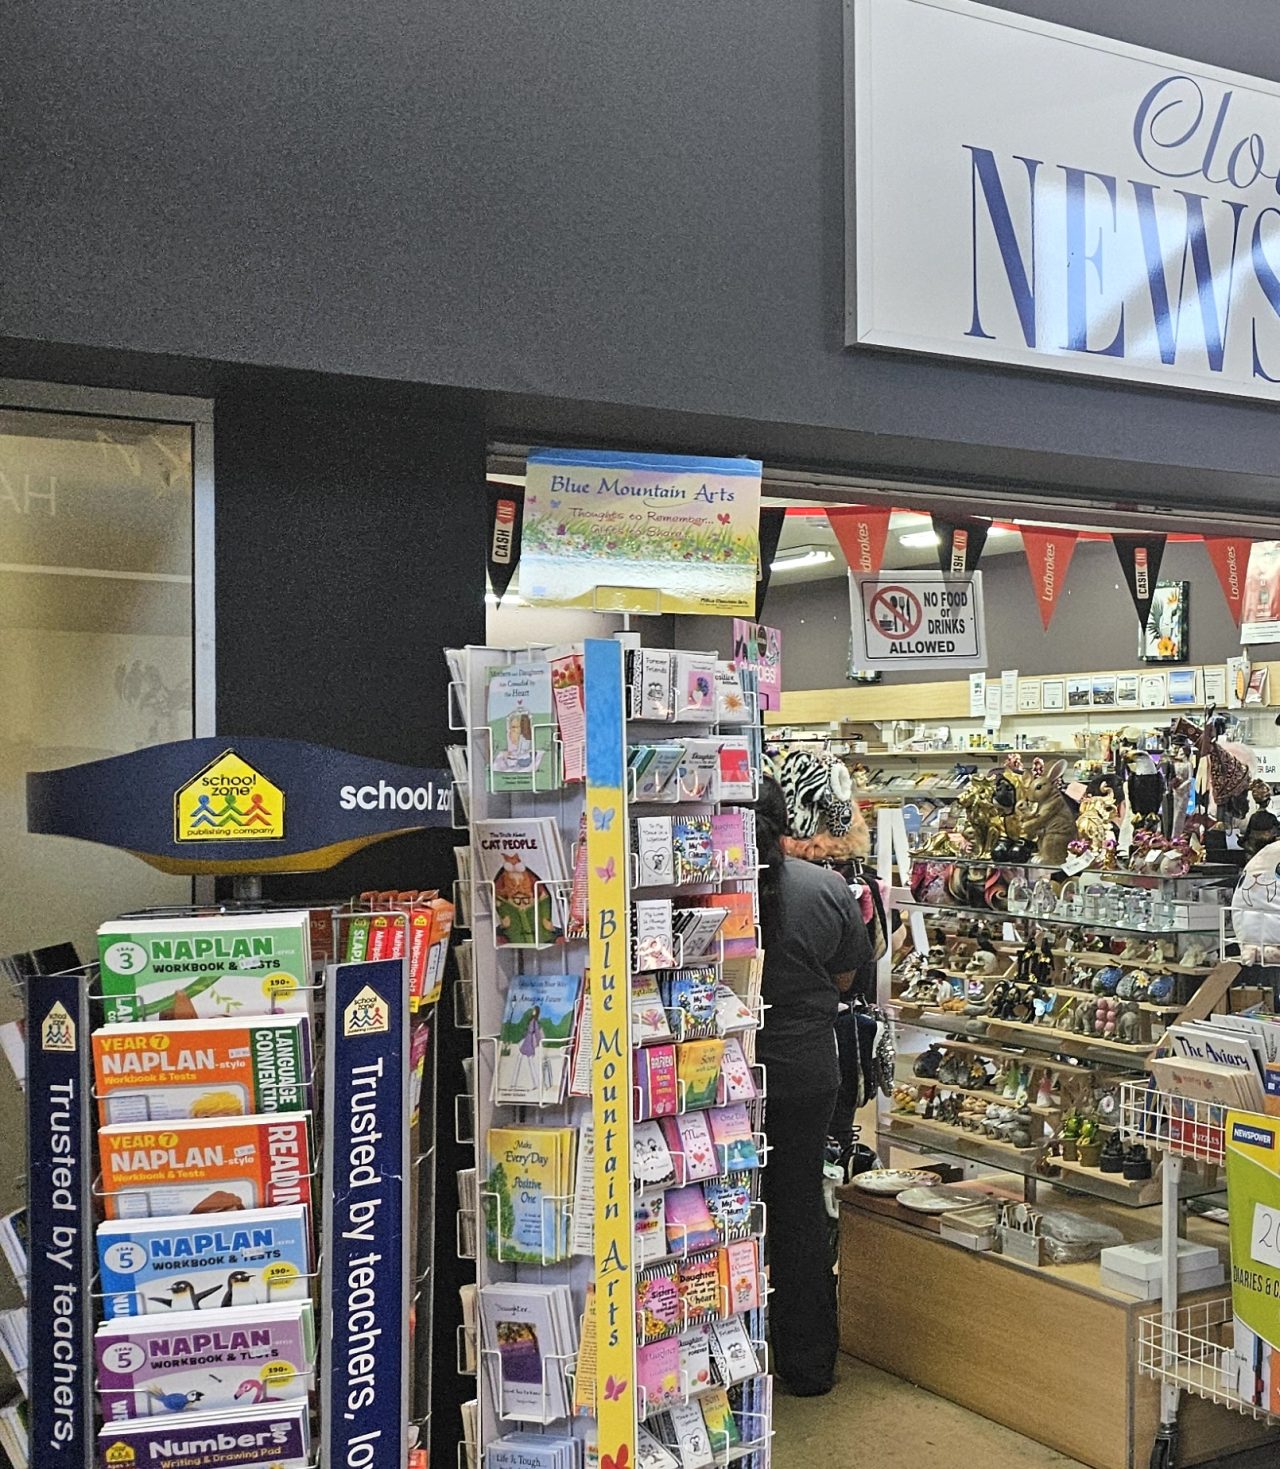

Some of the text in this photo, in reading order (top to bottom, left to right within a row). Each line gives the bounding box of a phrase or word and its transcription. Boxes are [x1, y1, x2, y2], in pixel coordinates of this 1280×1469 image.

[551, 475, 735, 504] Blue Mountain Arts
[569, 507, 624, 523] Thoughts
[494, 528, 511, 559] CASH
[1043, 543, 1056, 602] Ladbrokes
[1229, 546, 1237, 600] Ladbrokes
[1137, 569, 1147, 597] CASH
[924, 591, 968, 607] NO FOOD
[940, 608, 951, 618] or
[928, 619, 965, 635] DRINKS
[889, 640, 955, 655] ALLOWED
[202, 774, 257, 788] school
[210, 786, 252, 796] zone
[340, 781, 433, 811] school
[187, 826, 275, 838] publishing company
[482, 839, 537, 850] CAT PEOPLE
[151, 936, 274, 960] NAPLAN
[119, 953, 134, 969] 3
[153, 962, 238, 974] WORKBOOK &
[101, 1036, 164, 1051] YEAR 7
[101, 1049, 215, 1074] NAPLAN
[1175, 1036, 1251, 1071] The Aviary
[275, 1029, 298, 1104] LANGUAGE
[104, 1074, 156, 1086] Workbook
[169, 1072, 197, 1081] Tests
[110, 1133, 173, 1149] YEAR 7
[1234, 1129, 1271, 1143] NEWSPOWER
[111, 1145, 225, 1172] NAPLAN
[506, 1151, 548, 1166] Every Day
[113, 1170, 205, 1182] Workbook & Tests
[151, 1228, 274, 1257] NAPLAN
[342, 1056, 383, 1419] Trusted by teachers,
[48, 1079, 78, 1450] Trusted by teachers,
[119, 1252, 134, 1269] 5
[152, 1254, 238, 1271] WORKBOOK &
[1233, 1266, 1263, 1292] DIARIES
[1265, 1278, 1271, 1295] &
[149, 1328, 271, 1357] NAPLAN
[118, 1352, 132, 1368] 5
[151, 1353, 236, 1369] WORKBOOK &
[149, 1428, 288, 1459] Numbers
[161, 1458, 201, 1469] Writing
[213, 1450, 257, 1462] Drawing
[260, 1446, 281, 1456] Pad
